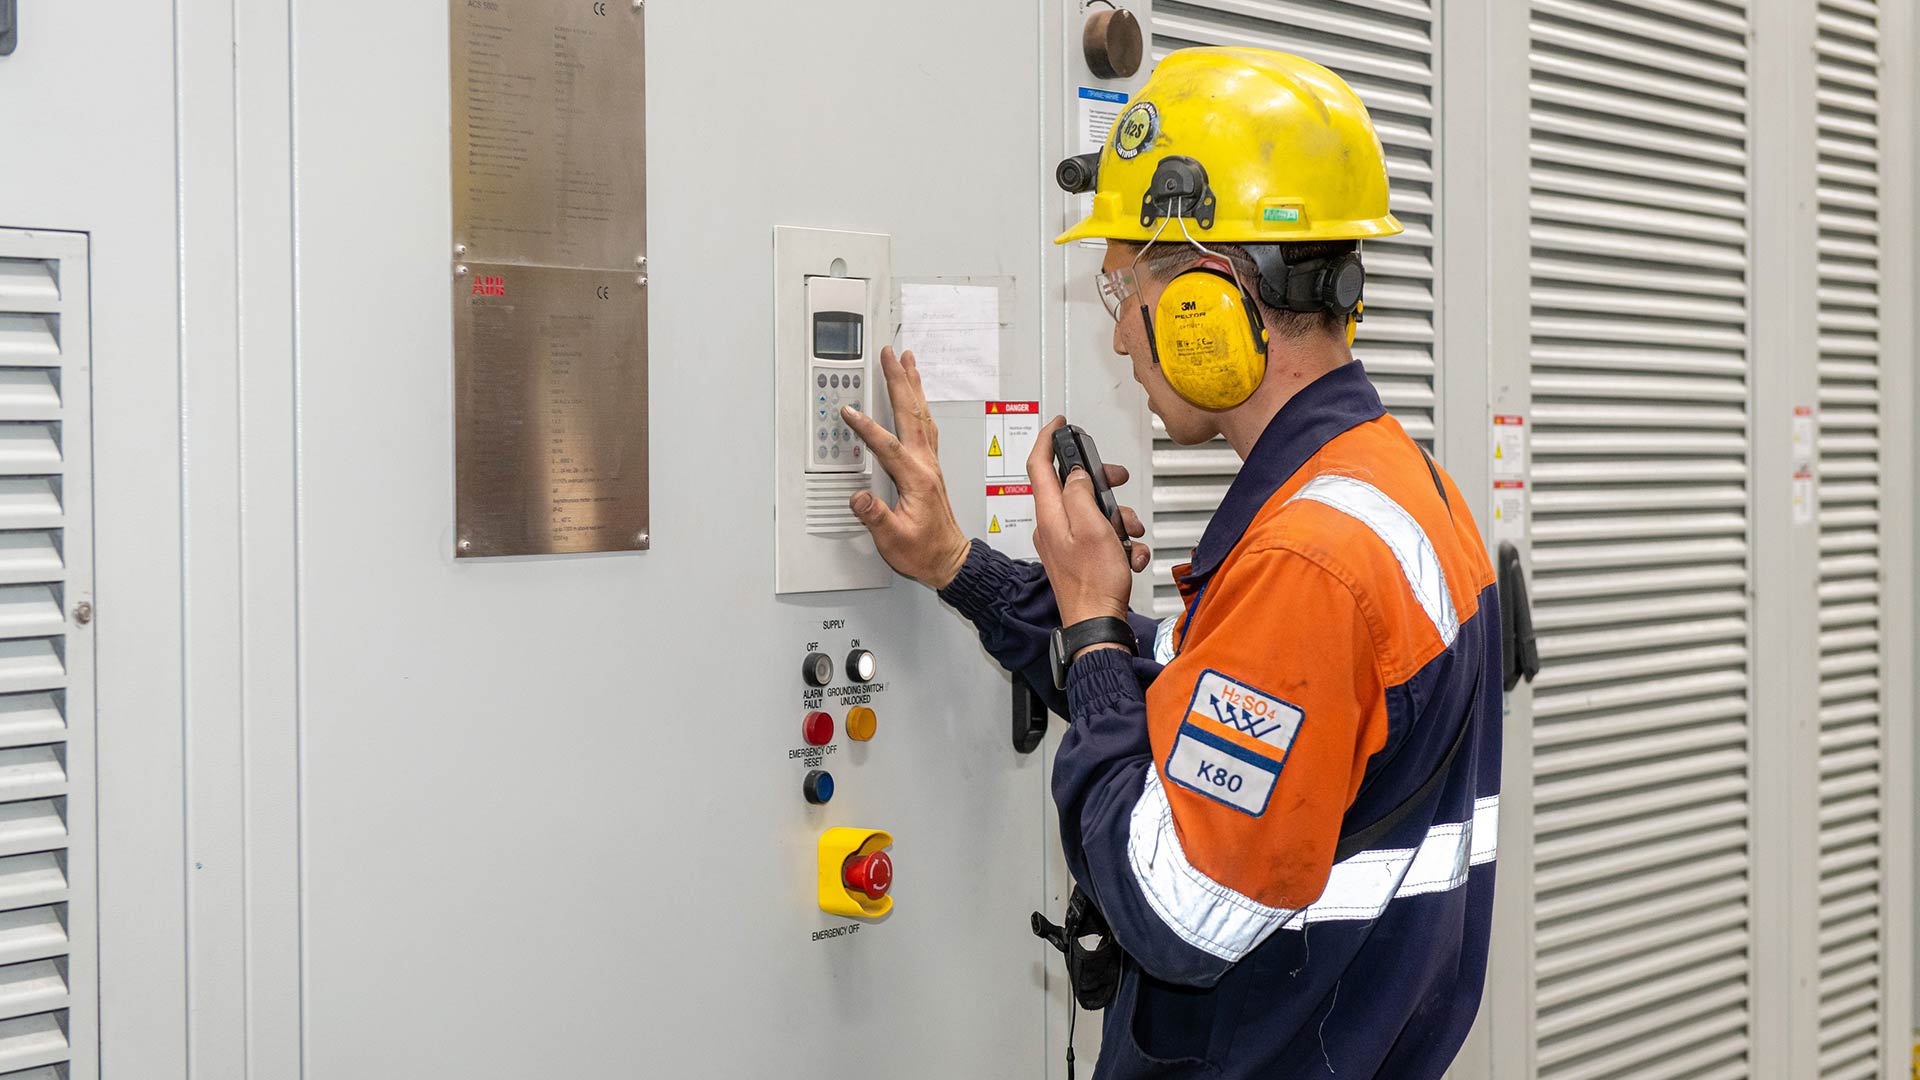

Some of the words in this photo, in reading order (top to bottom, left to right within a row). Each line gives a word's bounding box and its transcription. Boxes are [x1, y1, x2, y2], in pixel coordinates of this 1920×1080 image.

[1124, 120, 1144, 139] H2S
[472, 275, 505, 297] ABB
[1181, 301, 1196, 312] 3M
[1174, 312, 1206, 320] PELTOR
[1005, 403, 1029, 412] DANGER
[823, 620, 845, 629] SUPPLY
[806, 642, 818, 652] OFF
[851, 639, 860, 648] ON
[803, 688, 823, 699] ALARM
[827, 685, 861, 697] GROUNDING
[862, 683, 884, 694] SWITCH
[804, 699, 822, 709] FAULT
[840, 695, 871, 706] UNLOCKED
[789, 746, 825, 759] EMERGENCY
[825, 744, 837, 755] OFF
[803, 757, 822, 768] RESET
[1197, 760, 1243, 793] K80
[812, 925, 848, 941] EMERGENCY
[848, 923, 860, 934] OFF
